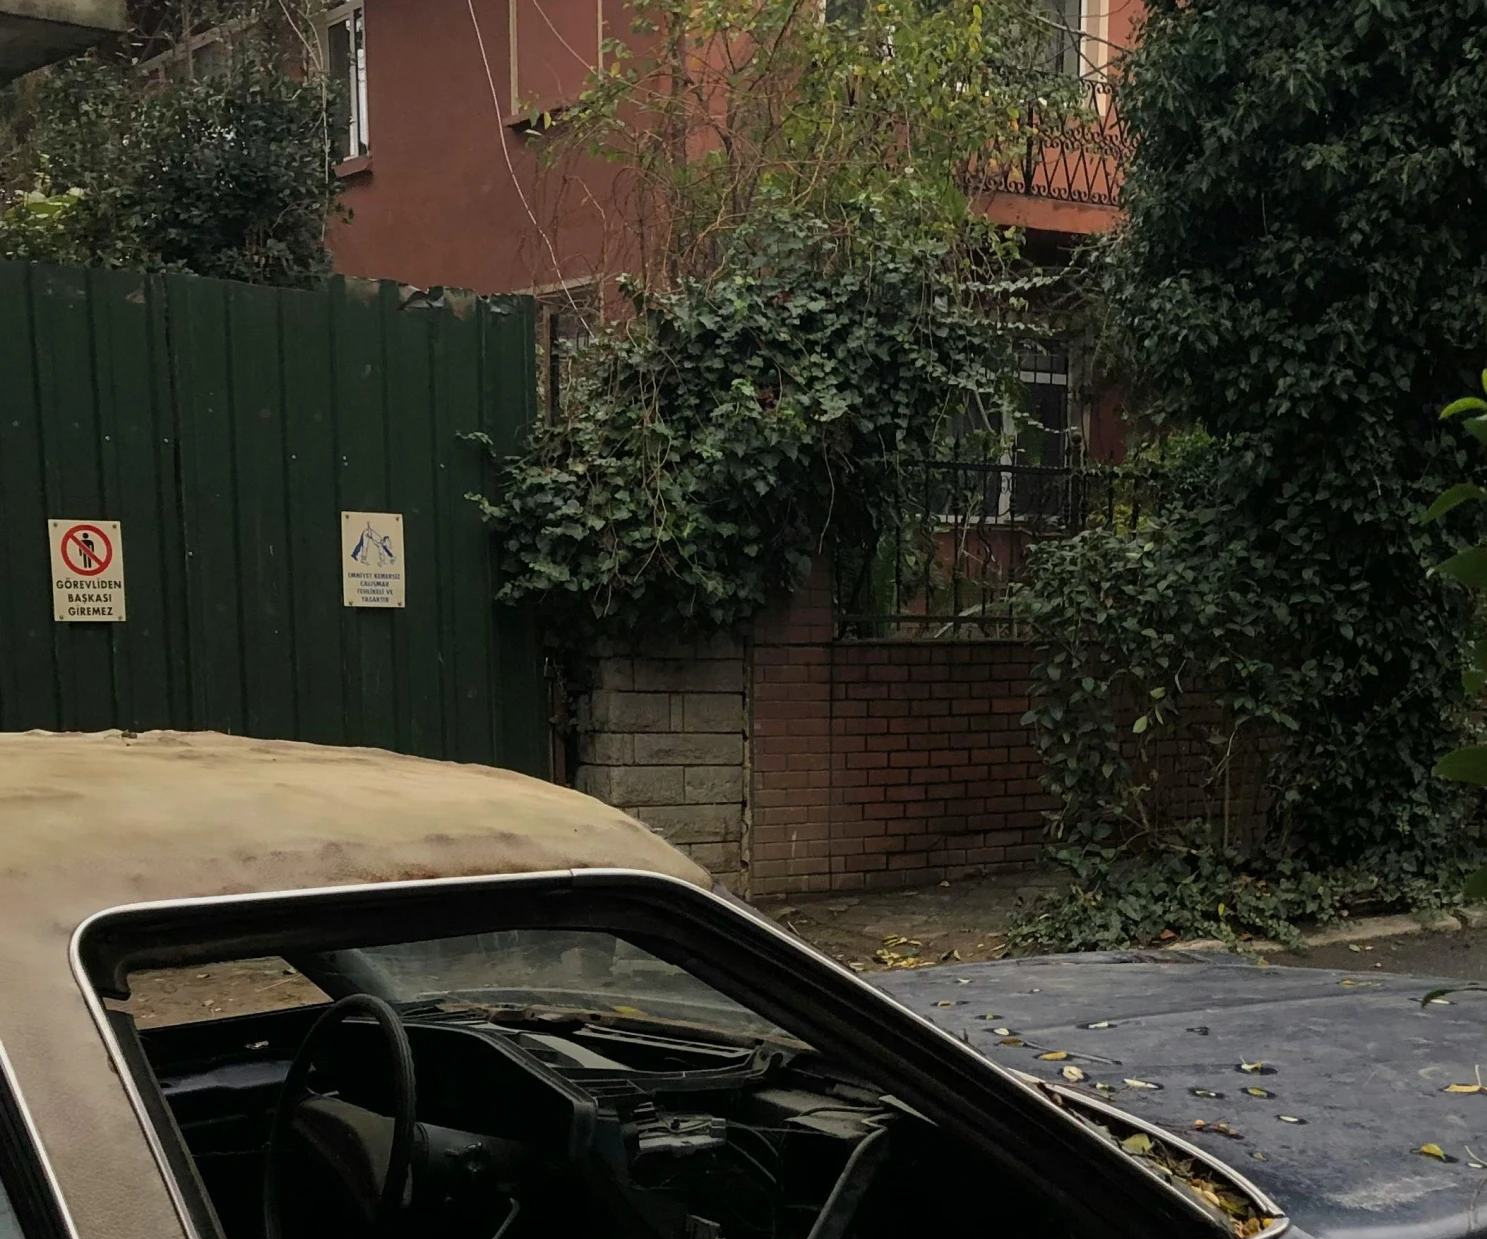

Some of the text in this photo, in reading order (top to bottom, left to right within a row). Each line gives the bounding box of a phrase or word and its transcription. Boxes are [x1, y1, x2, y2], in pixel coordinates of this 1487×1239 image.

[56, 577, 122, 589] GÖREVLİDEN
[67, 593, 112, 604] BAŞKASI
[68, 604, 113, 616] GİREMEZ
